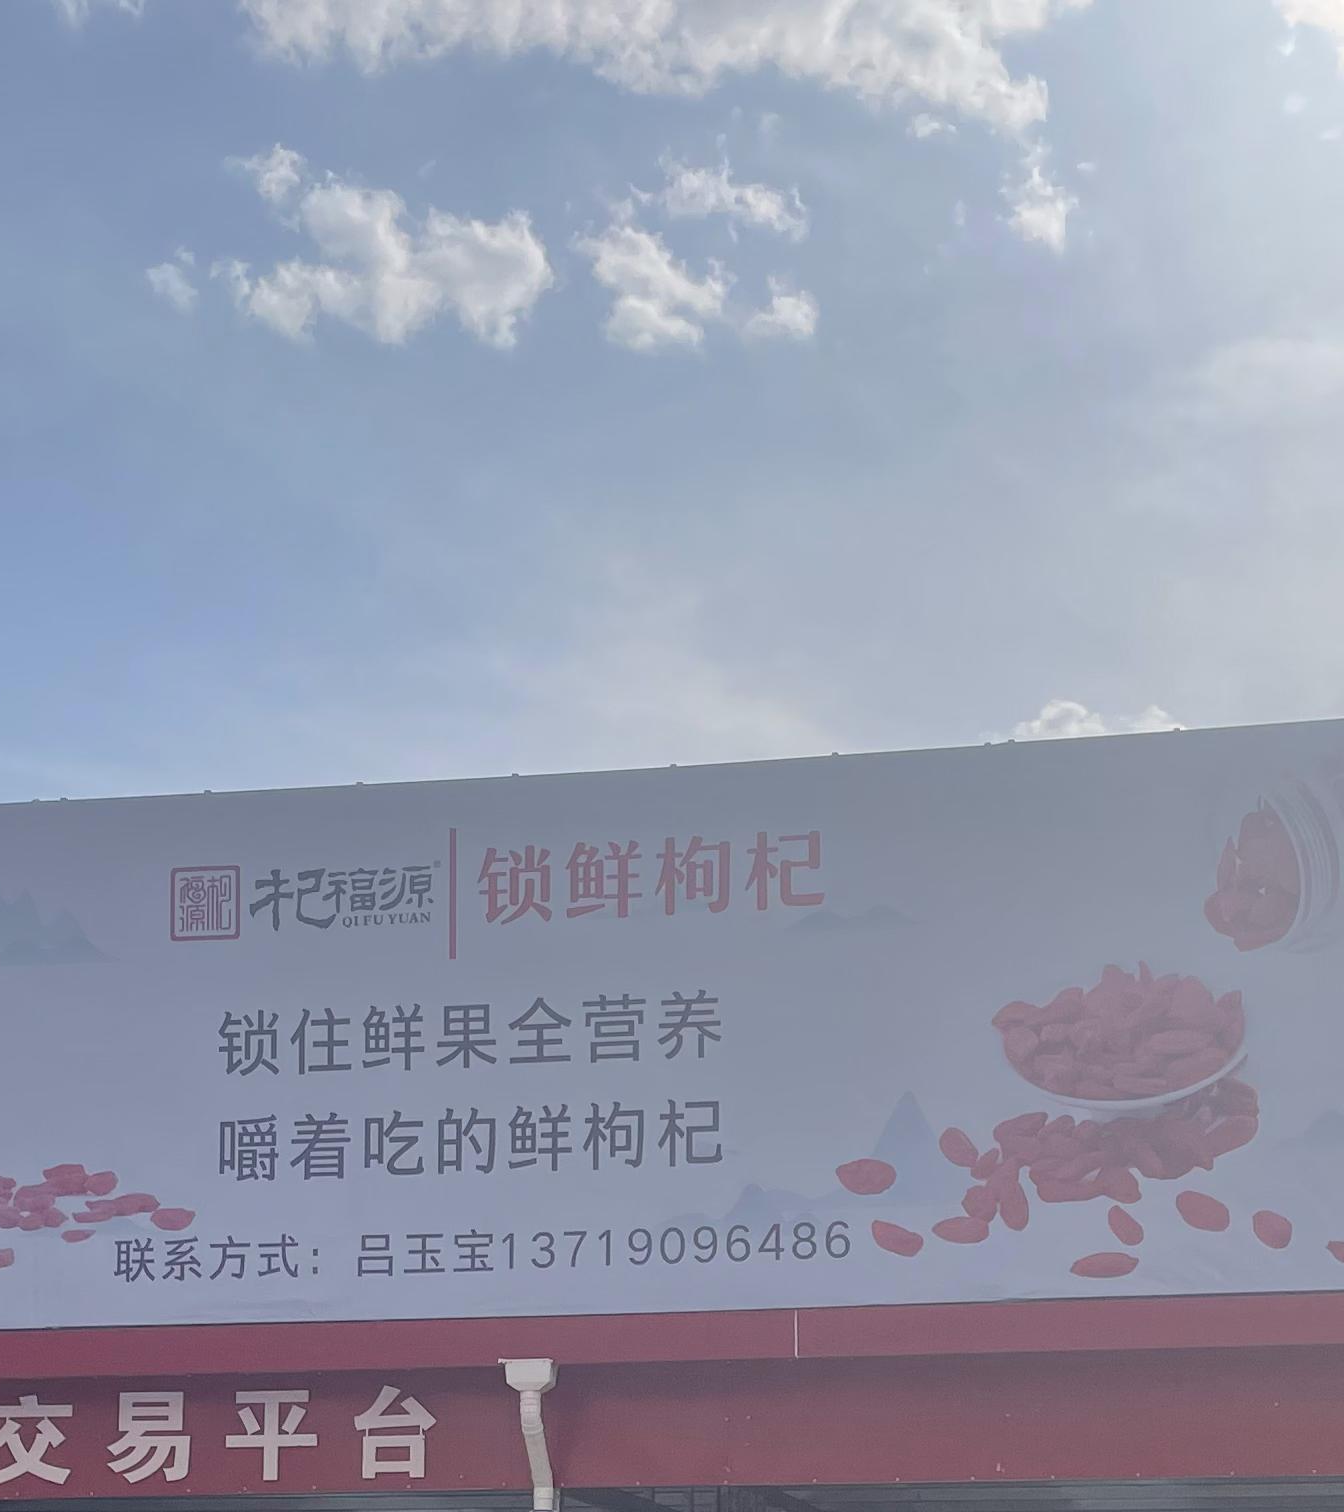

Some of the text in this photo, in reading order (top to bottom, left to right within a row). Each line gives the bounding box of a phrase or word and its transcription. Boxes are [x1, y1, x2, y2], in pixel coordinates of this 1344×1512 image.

[249, 865, 434, 931] 杞福源
[341, 910, 431, 928] QI FU YUAN
[477, 830, 826, 925] 锁鲜枸杞
[218, 989, 723, 1077] 锁住鲜果全营养
[218, 1098, 724, 1182] 嚼着吃的鲜枸杞
